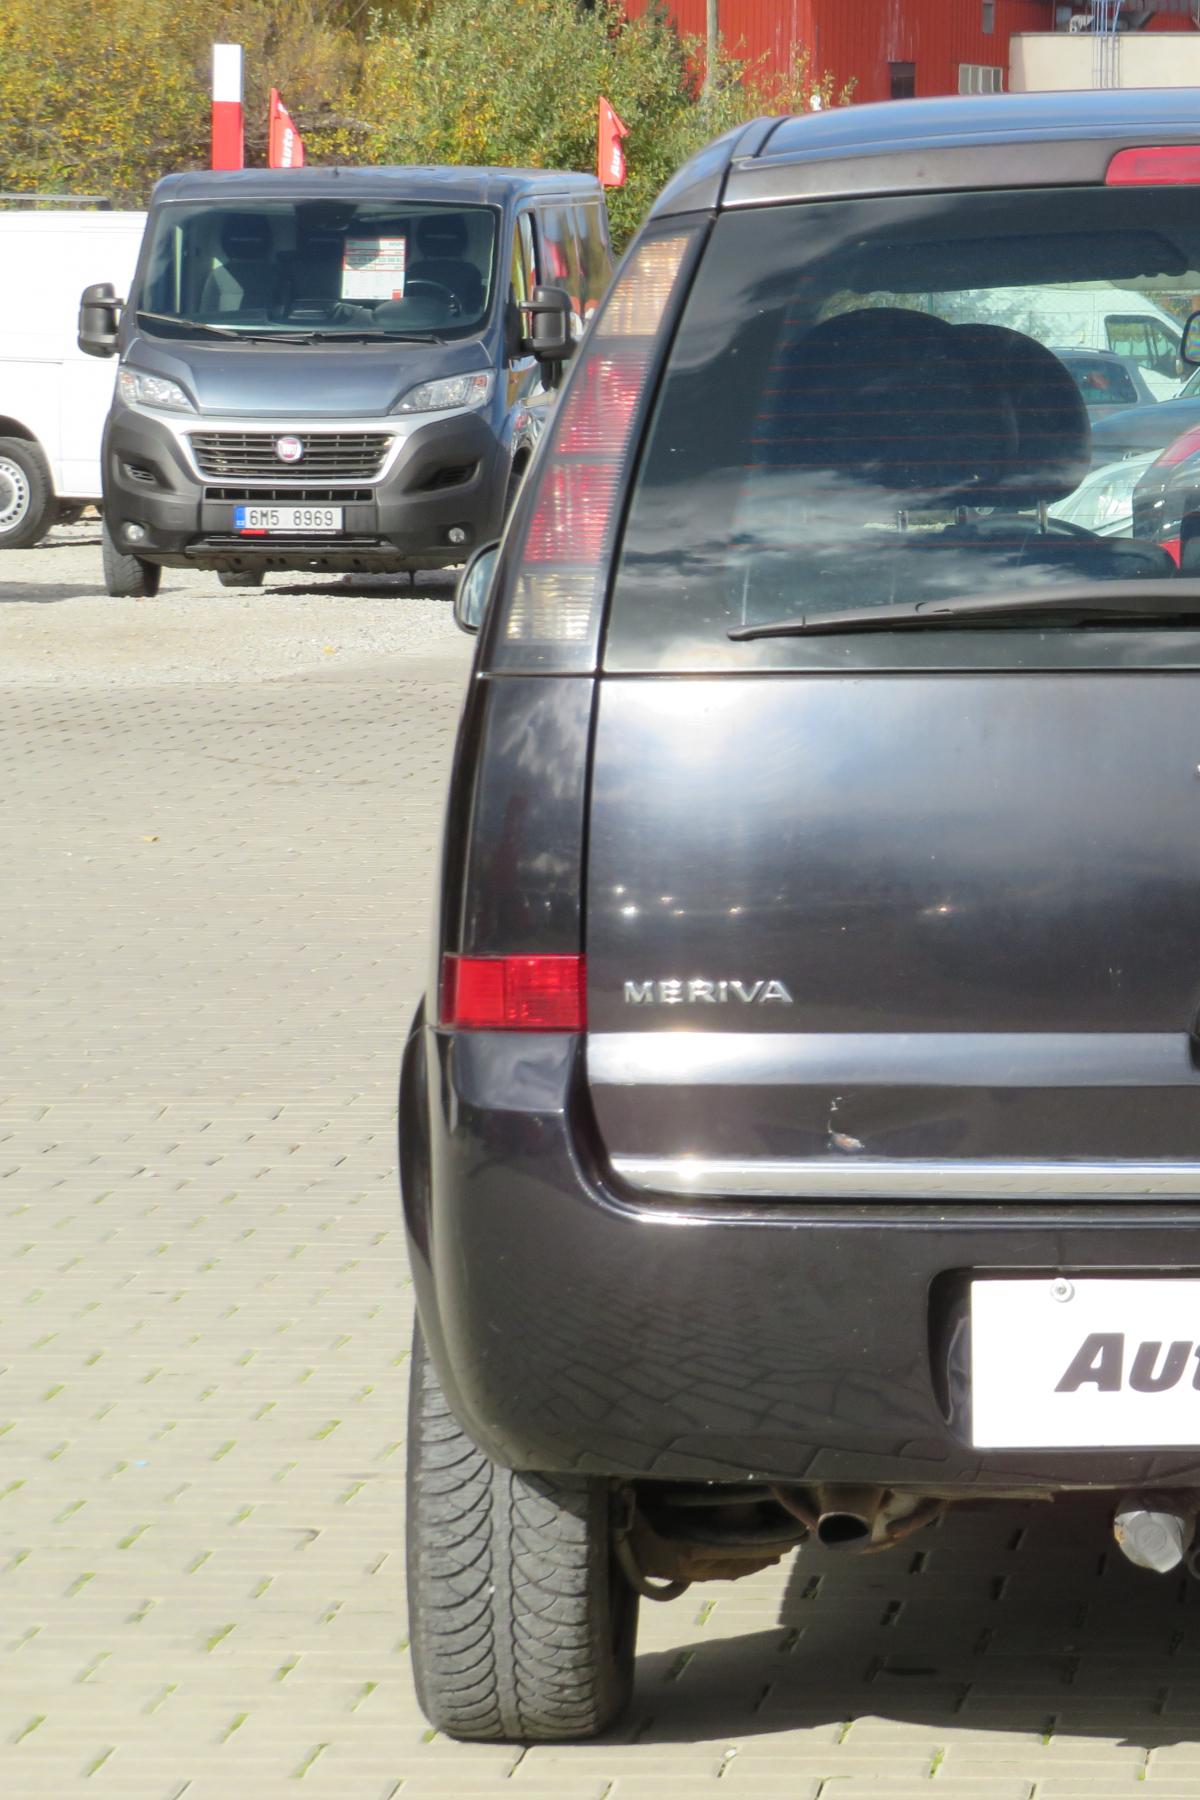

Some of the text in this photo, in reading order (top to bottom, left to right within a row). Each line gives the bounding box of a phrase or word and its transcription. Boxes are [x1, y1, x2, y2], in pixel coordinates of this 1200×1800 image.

[249, 510, 334, 527] 6M5 8969
[623, 979, 794, 1003] MERIVA
